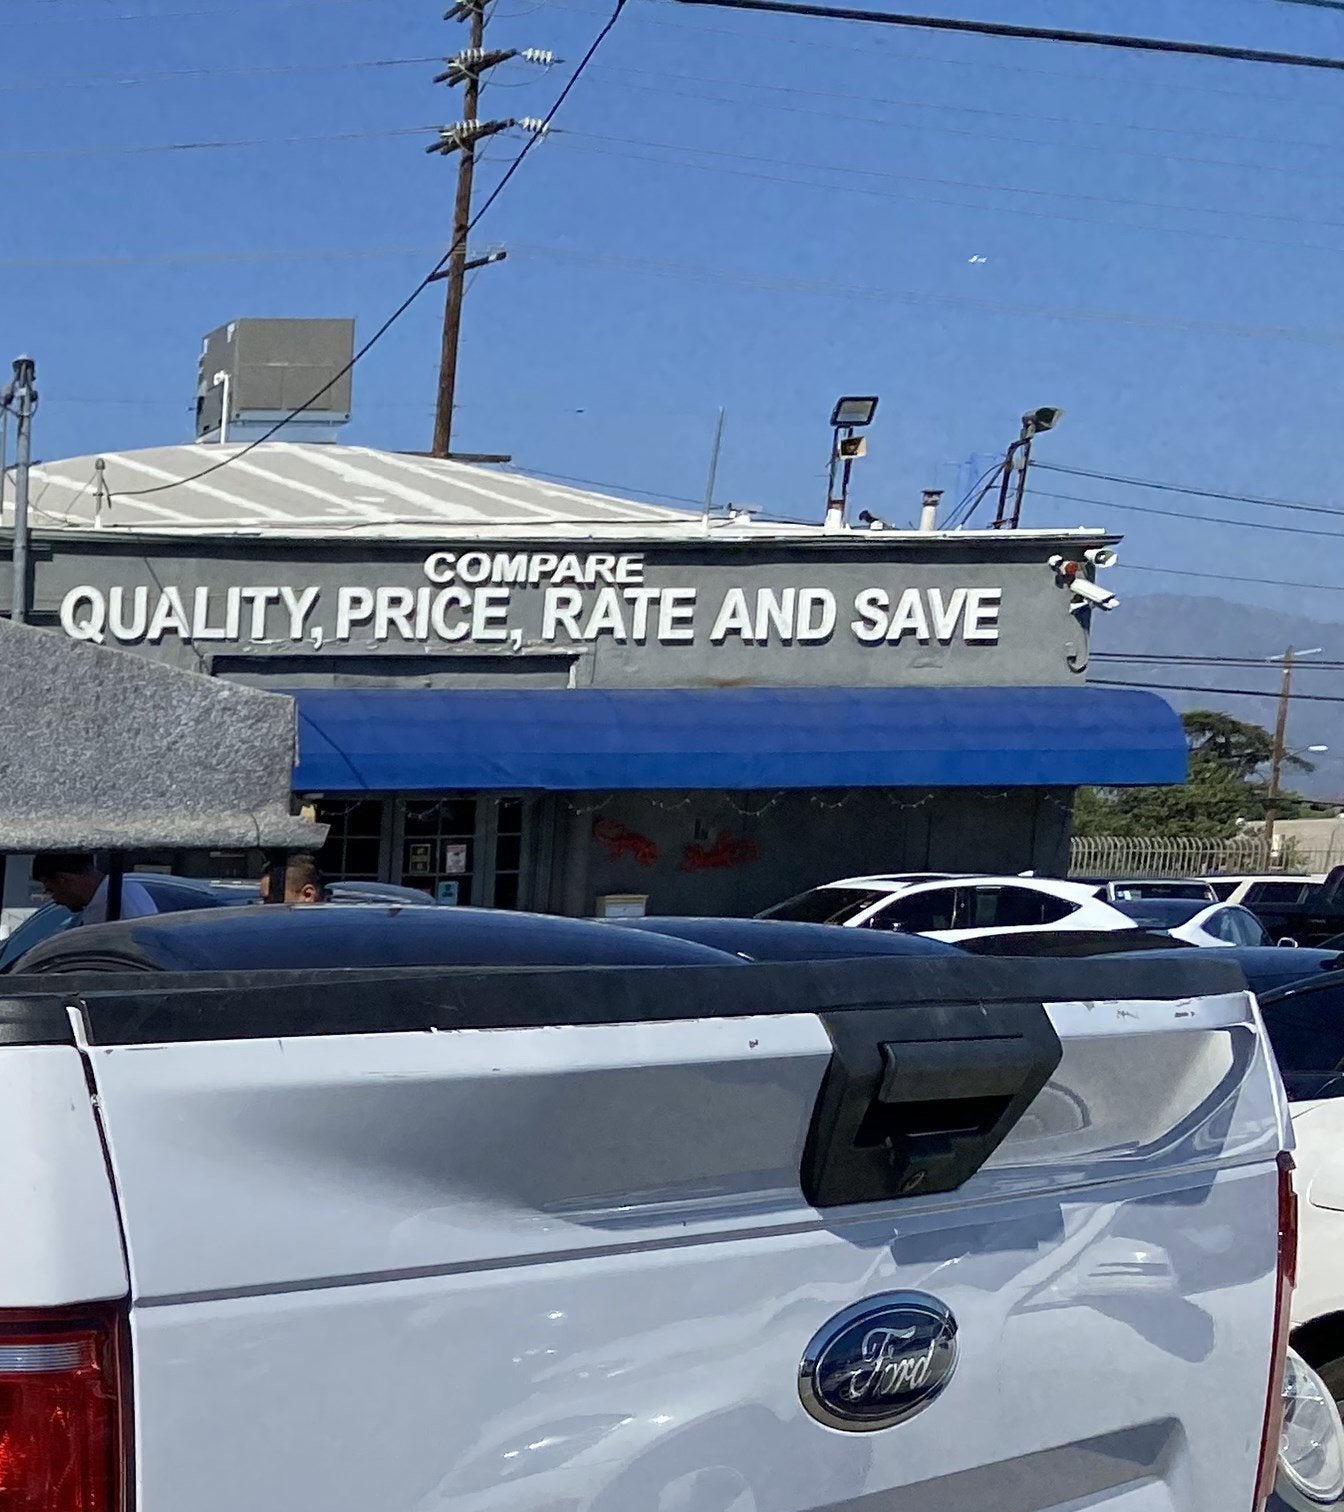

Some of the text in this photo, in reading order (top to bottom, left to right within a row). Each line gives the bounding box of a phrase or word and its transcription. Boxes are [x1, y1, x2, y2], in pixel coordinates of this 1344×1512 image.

[423, 552, 645, 583] COMPARE
[59, 585, 1003, 651] QUALITY, PRICE, RATE AND SAVE
[840, 1325, 936, 1402] Ford
